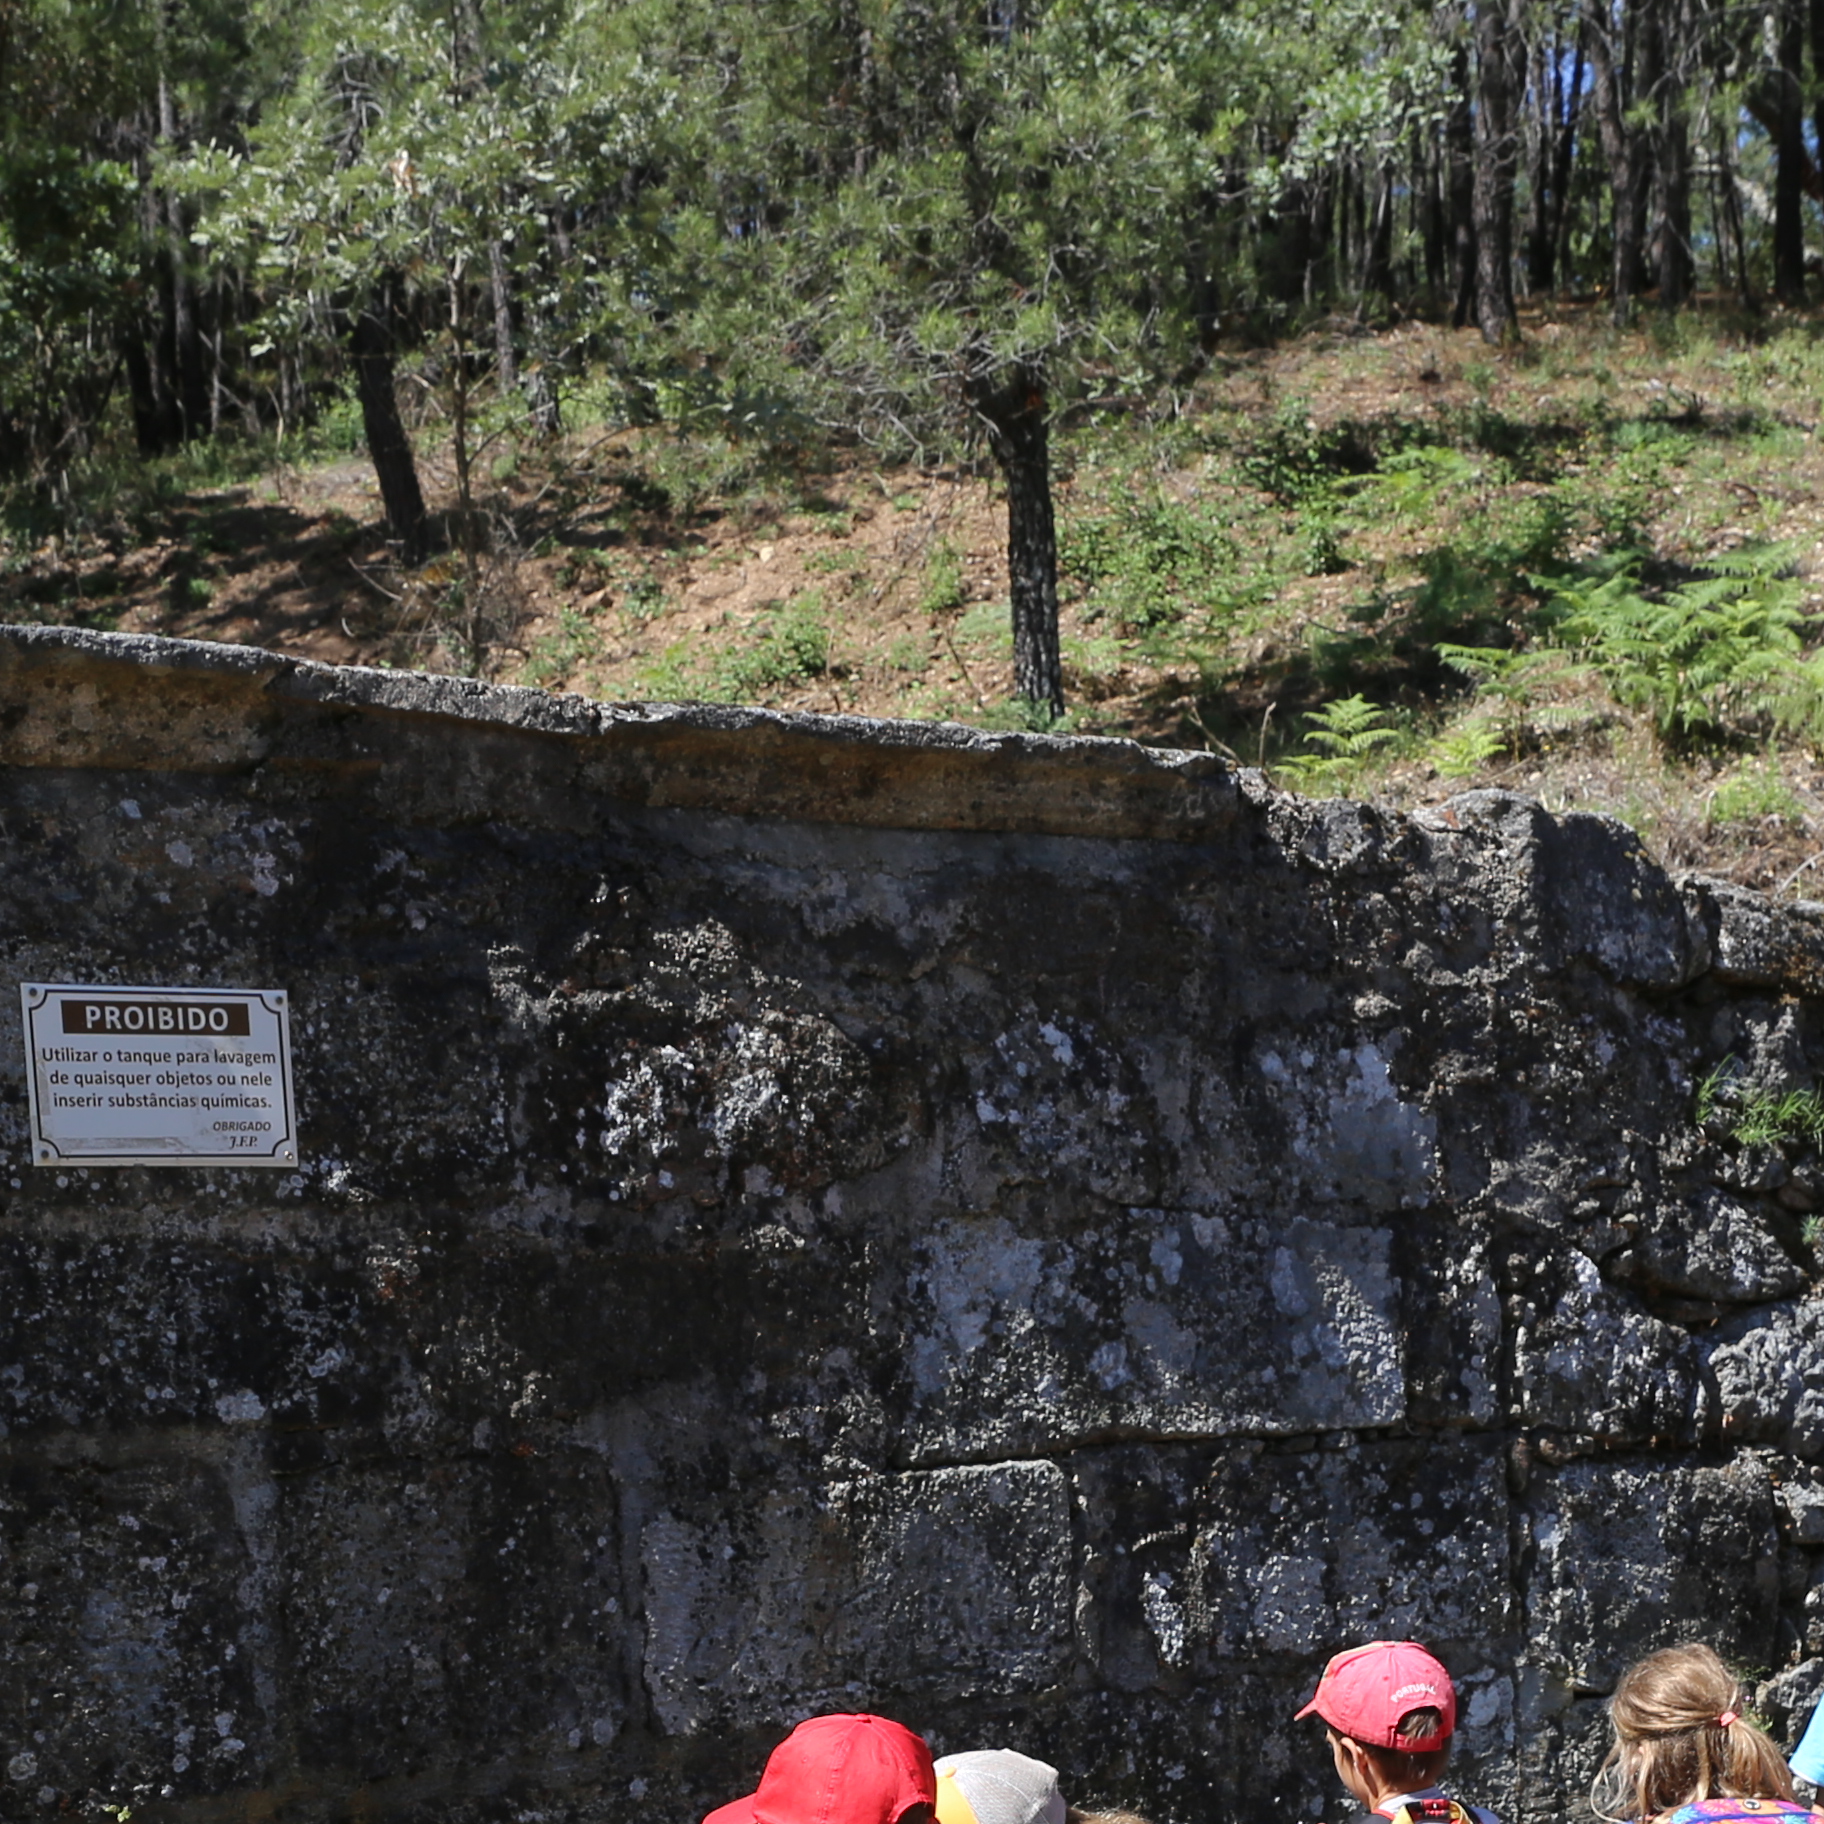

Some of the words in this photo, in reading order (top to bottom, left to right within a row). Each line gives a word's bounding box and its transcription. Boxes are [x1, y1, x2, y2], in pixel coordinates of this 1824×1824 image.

[85, 1005, 229, 1032] PROIBIDO
[42, 1047, 98, 1063] Utilizar
[103, 1052, 113, 1062] o
[117, 1049, 172, 1066] tanque
[177, 1052, 209, 1067] para
[214, 1049, 276, 1067] lavagem
[50, 1070, 69, 1085] de
[74, 1071, 151, 1089] quaisquer
[156, 1071, 213, 1089] objetos
[217, 1075, 237, 1086] ou
[241, 1072, 272, 1086] nele
[53, 1093, 104, 1108] inserir
[108, 1092, 197, 1108] substâncias
[201, 1094, 272, 1111] químicas.
[212, 1121, 271, 1132] OBRIGADO
